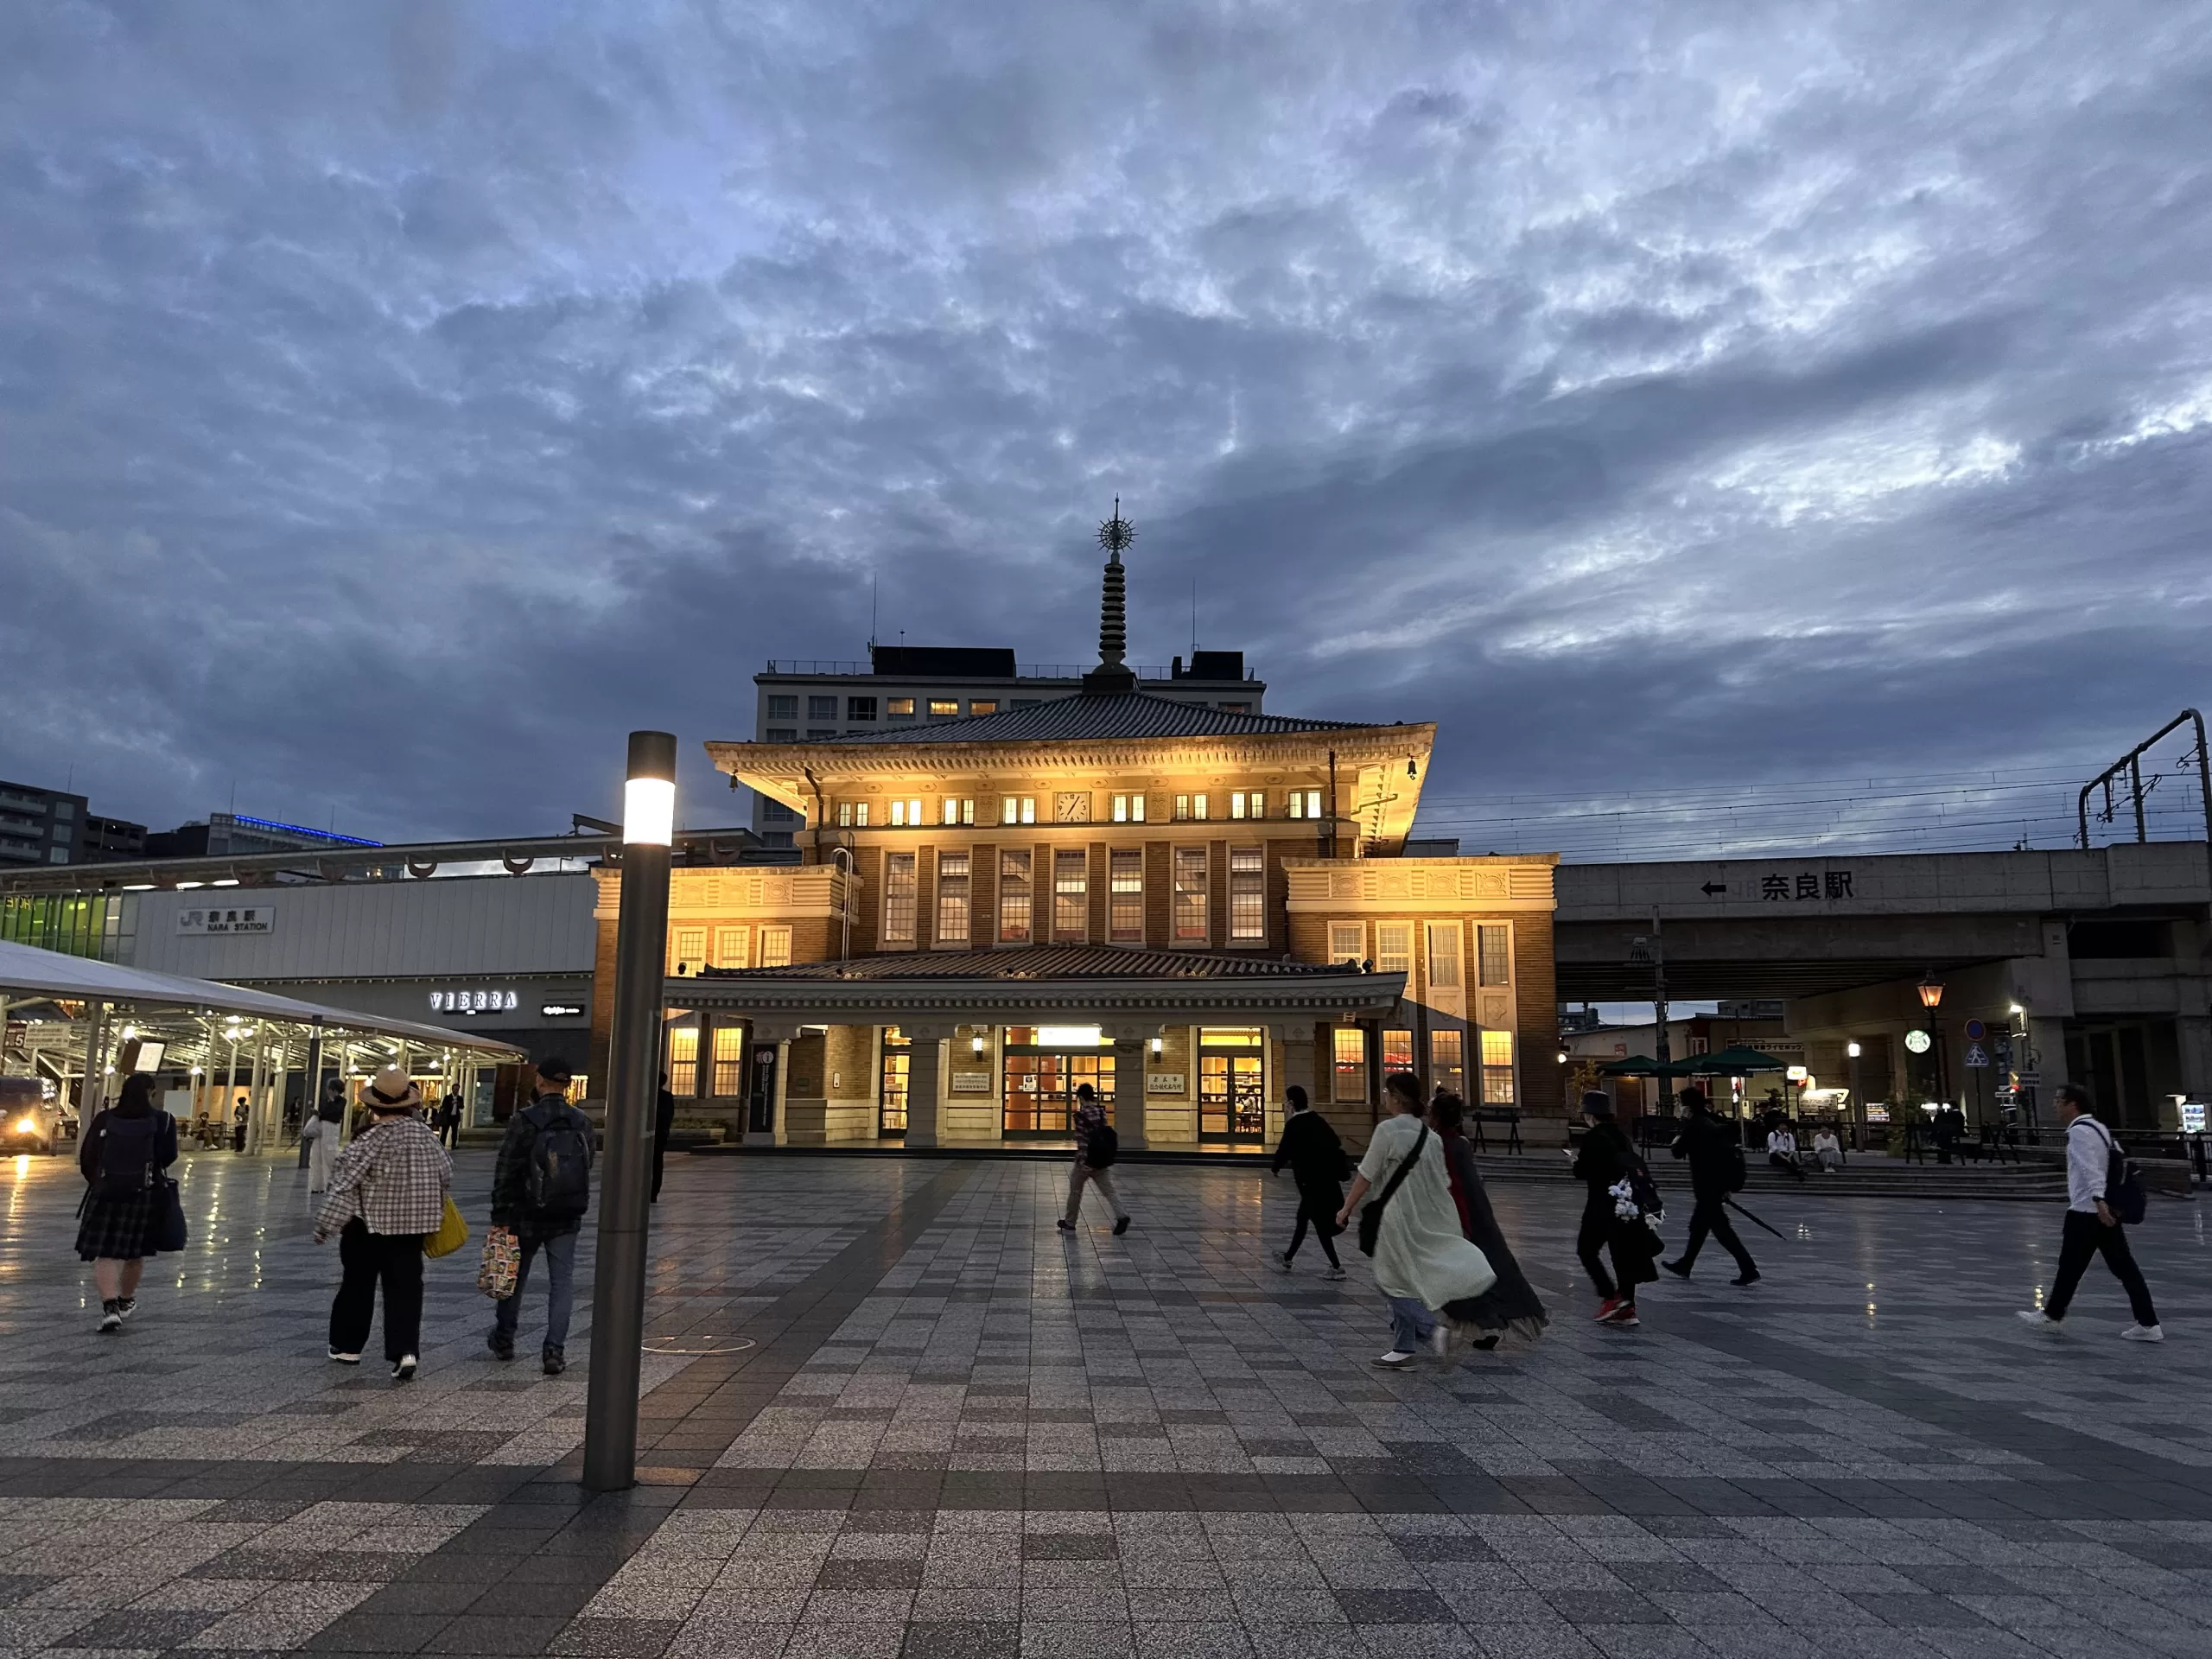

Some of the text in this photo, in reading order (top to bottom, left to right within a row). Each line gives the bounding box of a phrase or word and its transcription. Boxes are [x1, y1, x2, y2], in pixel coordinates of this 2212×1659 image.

[1731, 871, 1854, 900] JR 奈良駅
[181, 910, 256, 927] JR 奈良駅
[207, 922, 268, 931] NARA STATION
[430, 993, 516, 1009] VIERRA
[15, 1034, 24, 1046] 5
